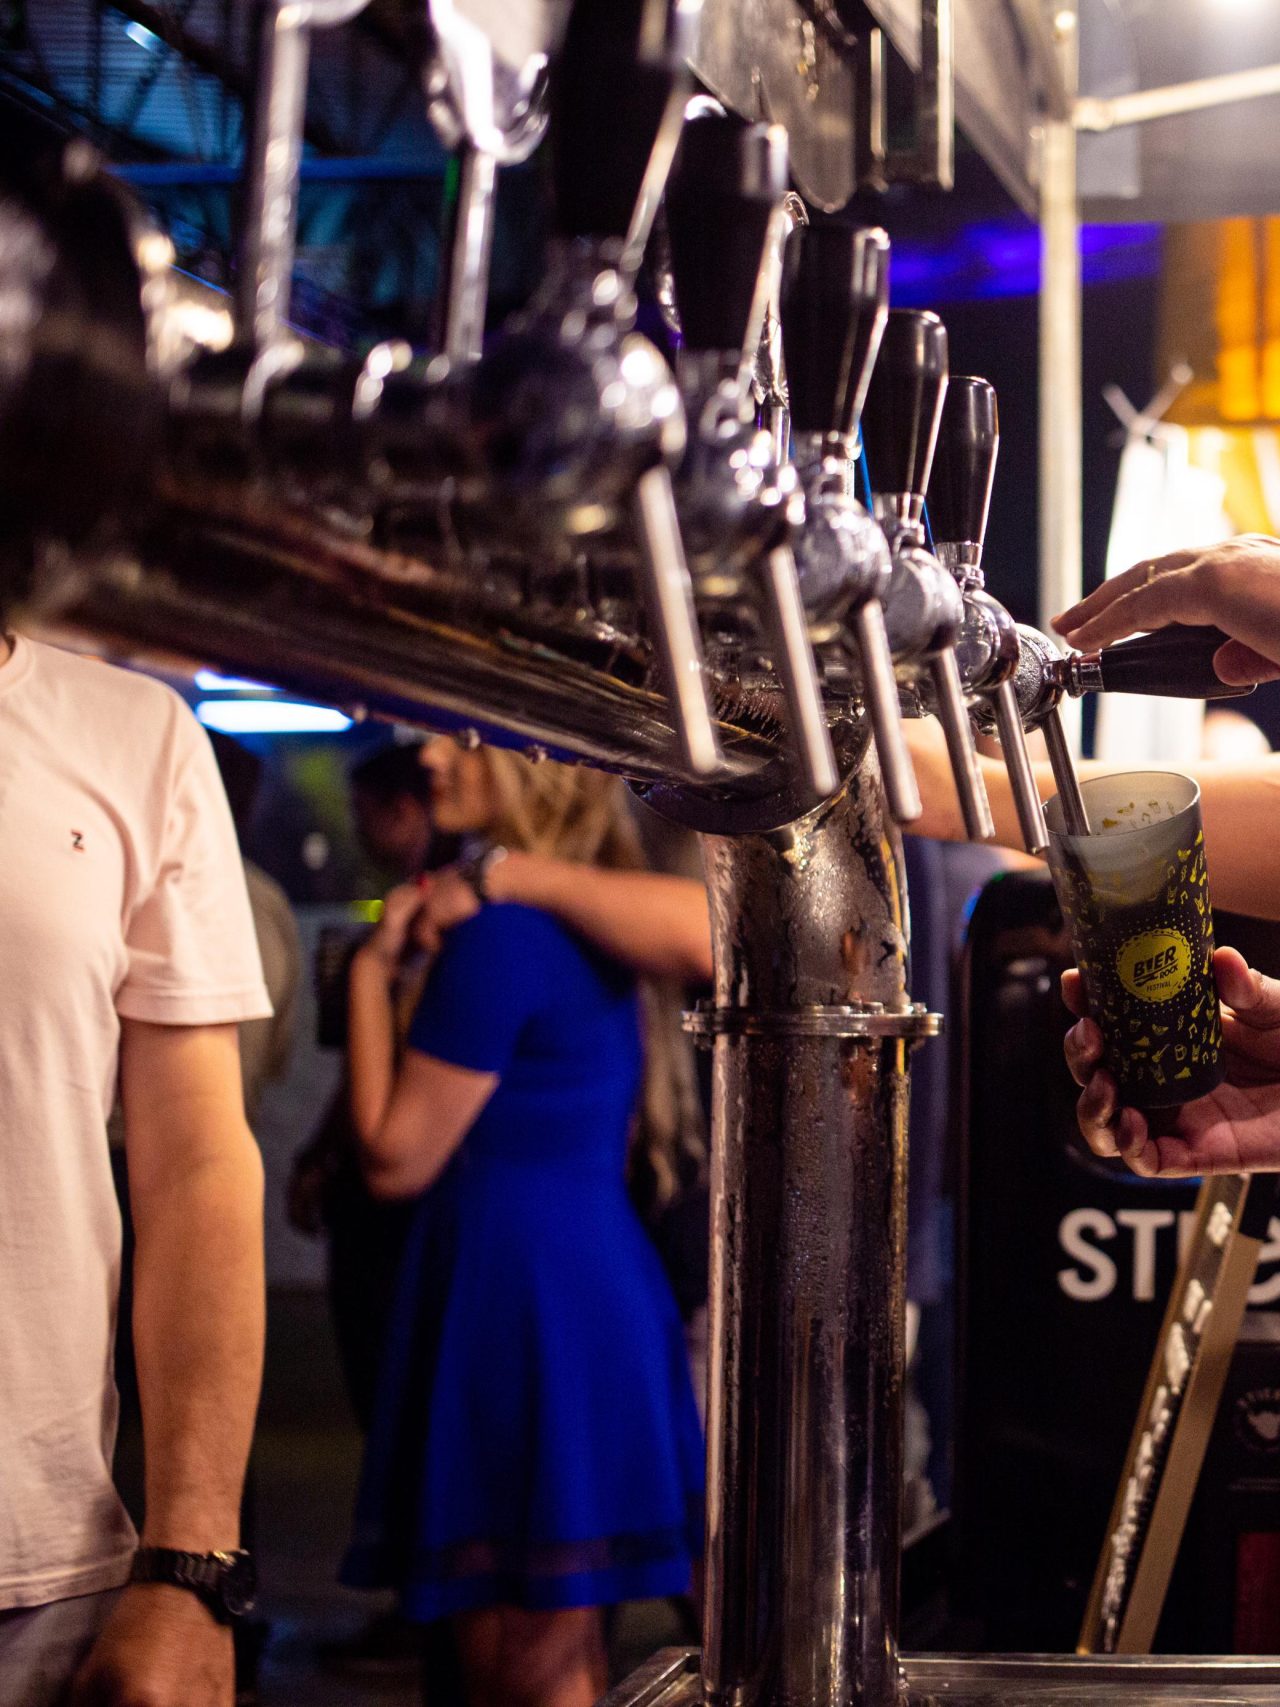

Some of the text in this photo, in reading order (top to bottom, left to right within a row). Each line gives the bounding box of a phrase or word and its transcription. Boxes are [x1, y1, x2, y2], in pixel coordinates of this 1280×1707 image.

[1133, 946, 1177, 978] BIER
[1160, 964, 1179, 979] ROCK
[1146, 981, 1171, 992] FESTIVAL
